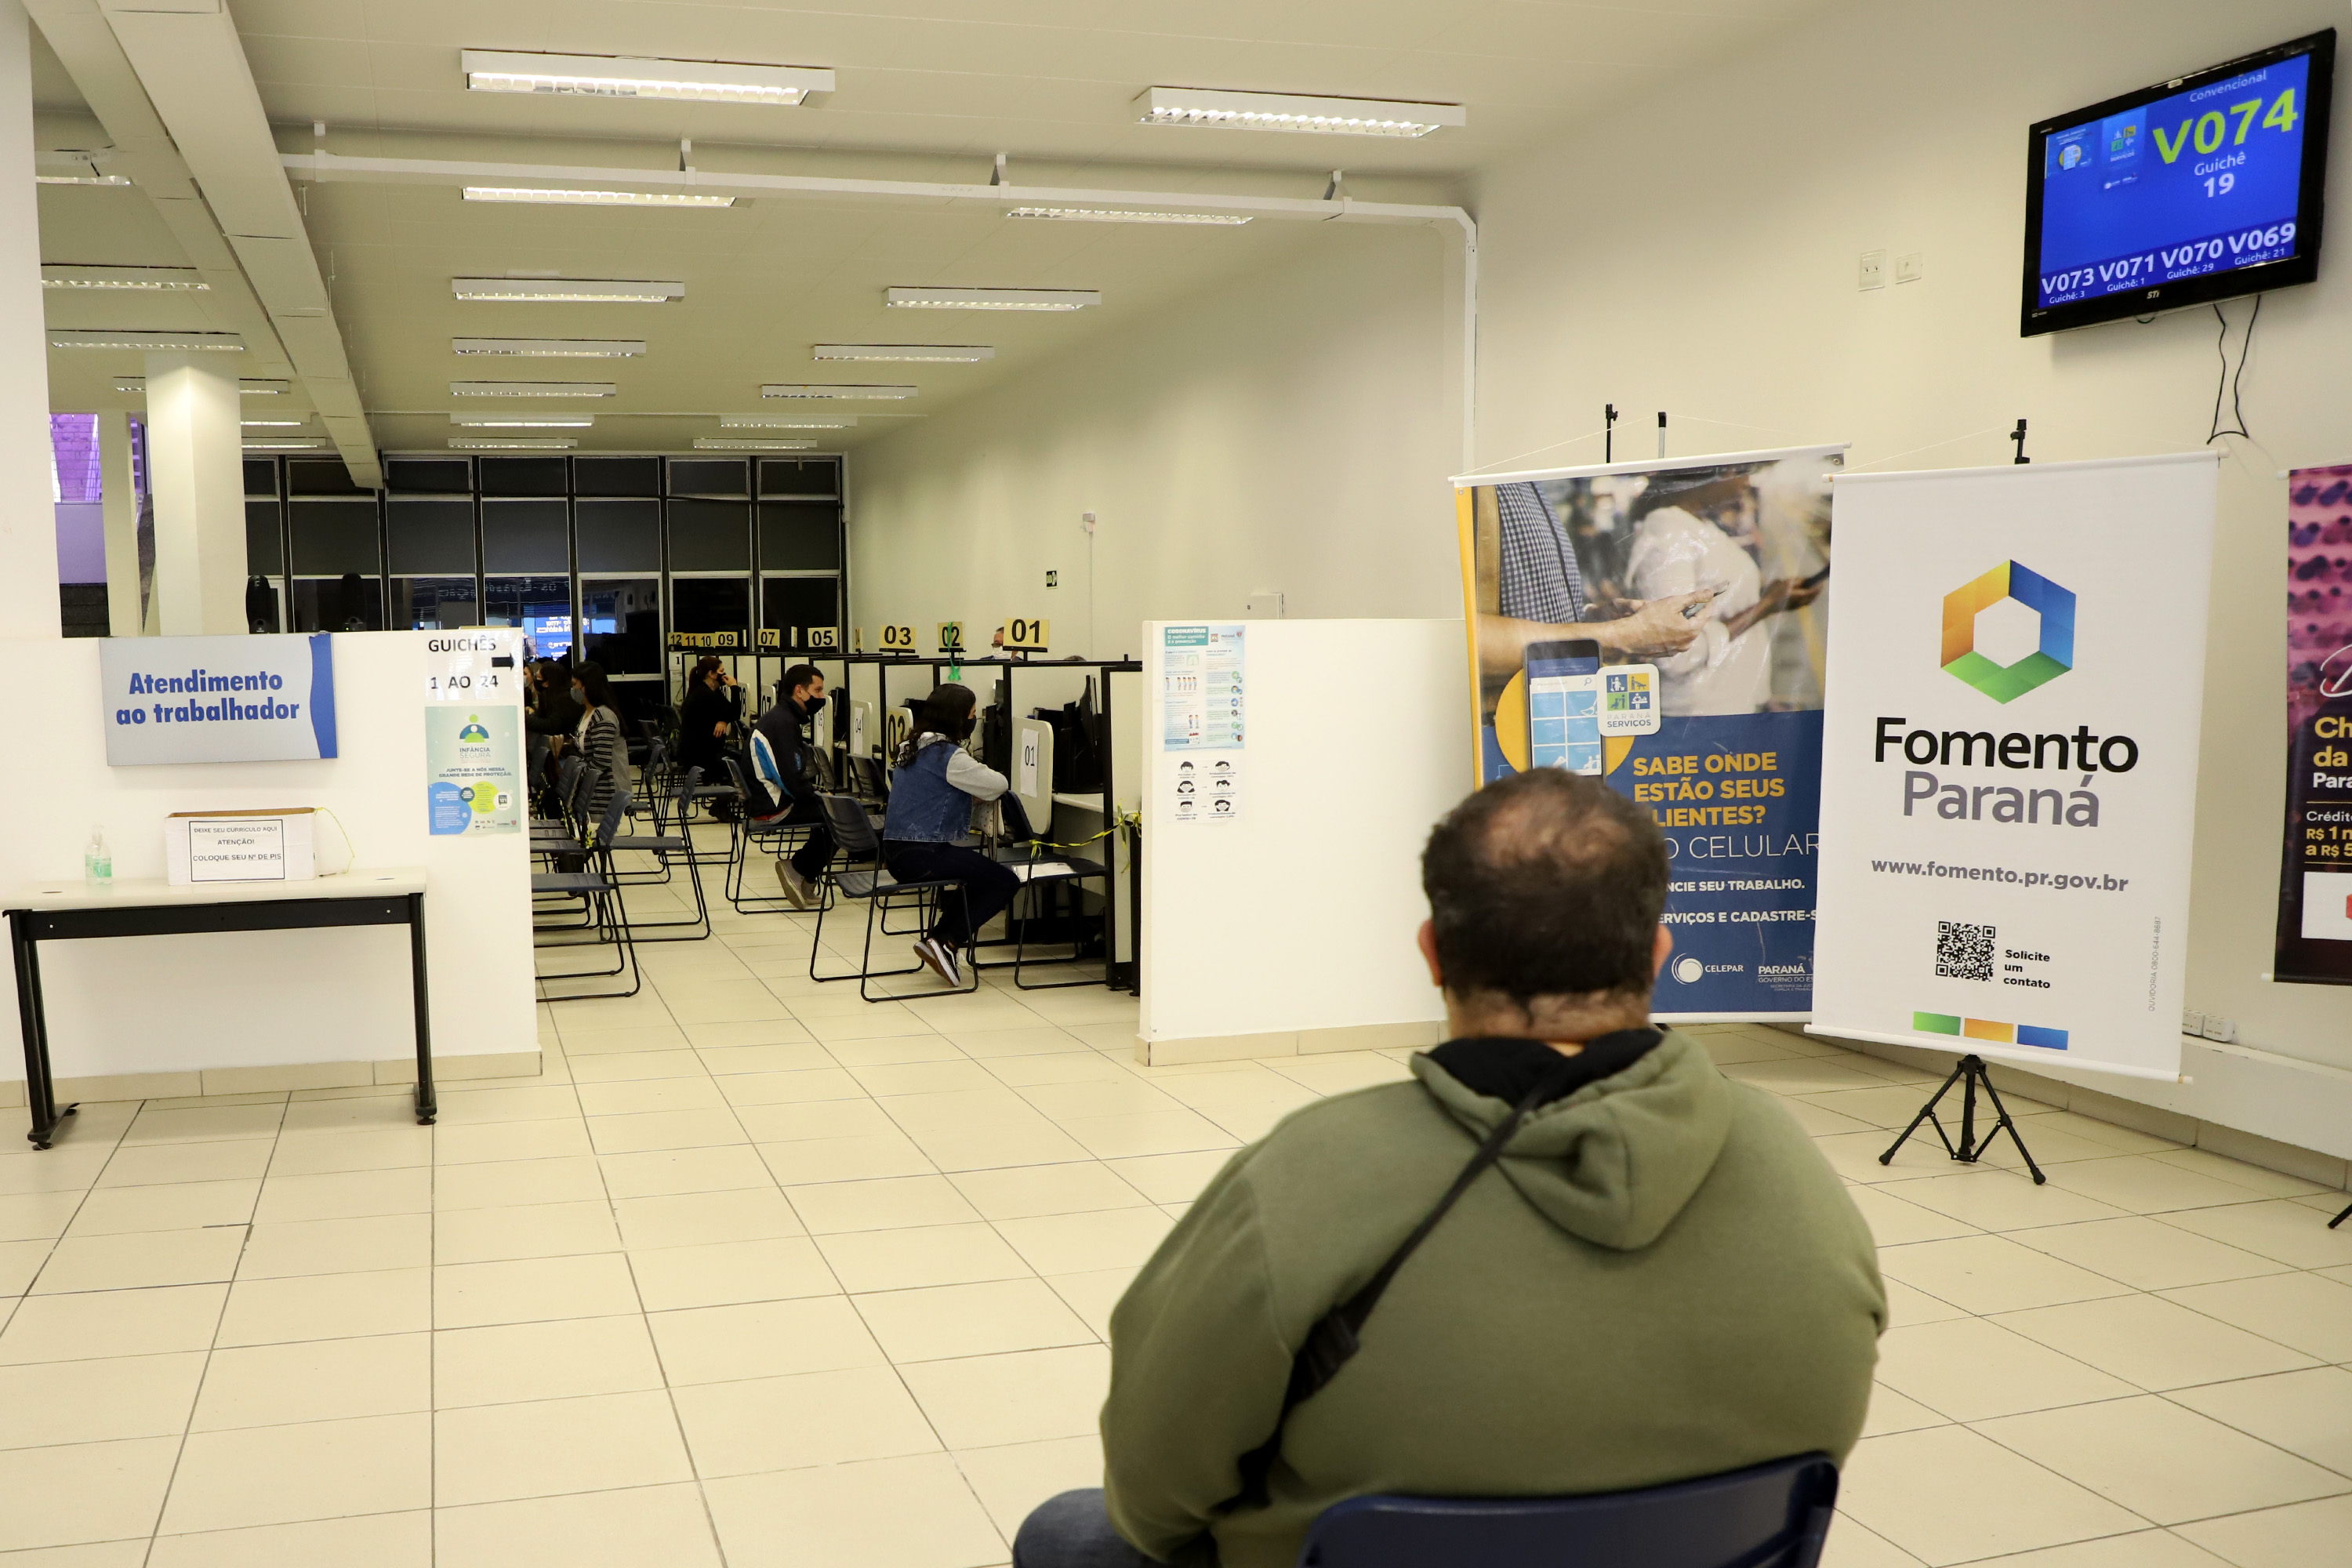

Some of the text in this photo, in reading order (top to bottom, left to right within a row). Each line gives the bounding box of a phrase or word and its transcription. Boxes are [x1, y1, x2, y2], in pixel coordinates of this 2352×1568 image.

[2190, 69, 2267, 103] Convencional
[2153, 88, 2299, 165] V074
[2194, 151, 2247, 176] Guichê
[2204, 173, 2235, 198] 19
[2042, 222, 2296, 295] V073 V071 V070 V069
[2234, 248, 2285, 266] Guichê: 21
[2167, 263, 2215, 280] Guichê: 29
[2107, 278, 2139, 293] Guichê:
[2049, 289, 2085, 304] Guichê: 3
[670, 634, 681, 645] 12
[718, 633, 734, 646] 09
[760, 631, 775, 645] 07
[812, 630, 833, 646] 05
[884, 625, 912, 646] 03
[942, 626, 960, 647] 02
[1011, 619, 1041, 643] 01
[428, 634, 496, 652] GUICHÊS
[685, 635, 696, 646] 11
[701, 635, 712, 646] 10
[129, 669, 283, 695] Atendimento
[430, 675, 499, 689] 1 AO 24
[116, 698, 299, 724] ao trabalhador
[1607, 711, 1650, 720] PARANÁ
[855, 718, 862, 734] 04
[1607, 719, 1651, 728] SERVIÇOS
[2314, 717, 2352, 739] Ch
[1875, 717, 2139, 773] Fomento
[1025, 745, 1035, 767] 01
[1633, 751, 1777, 776] SABE ONDE
[2313, 746, 2348, 768] da
[2313, 772, 2352, 789] Para
[1635, 777, 1785, 802] ESTÃO SEUS
[1904, 770, 2100, 827] Paraná
[1653, 805, 1766, 827] LIENTES?
[2307, 828, 2325, 841] R$
[2328, 826, 2338, 840] 1
[1689, 833, 1819, 859] CELULAR
[2305, 845, 2352, 858] a R$ 5
[1871, 858, 2129, 891] www.fomento.pr.gov.br
[1666, 879, 1806, 892] NCIE SEU TRABALHO.
[1658, 909, 1816, 926] ERVIÇOS E CADASTRE-S
[2005, 949, 2050, 963] Solicite
[1704, 964, 1744, 974] CELEPAR
[1758, 963, 1806, 975] PARANÁ
[2004, 964, 2024, 973] um
[2003, 975, 2051, 989] contato
[2149, 971, 2158, 1011] OUVIDORIA
